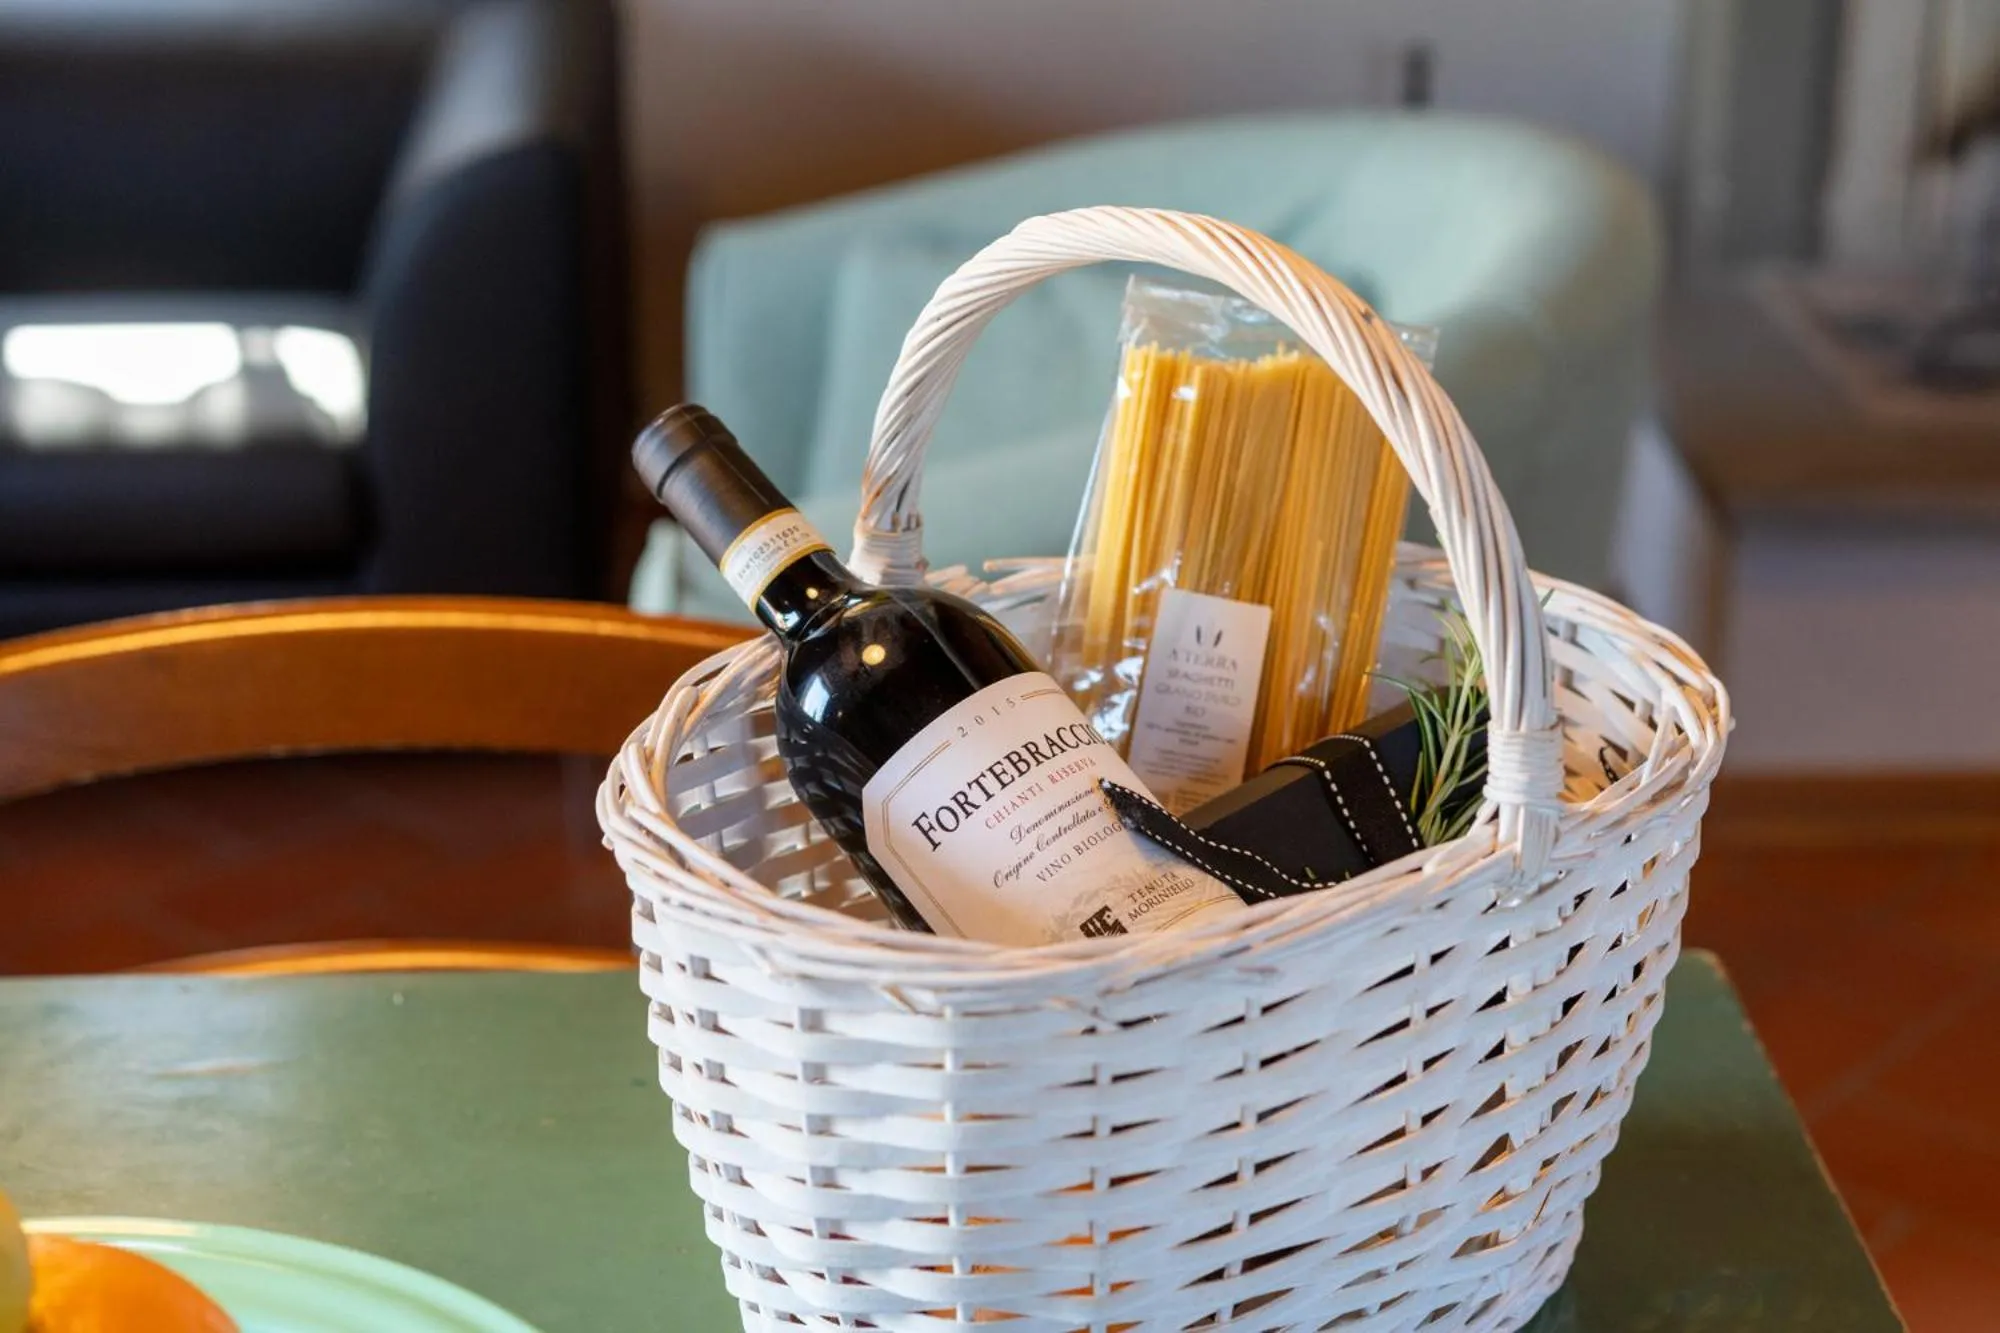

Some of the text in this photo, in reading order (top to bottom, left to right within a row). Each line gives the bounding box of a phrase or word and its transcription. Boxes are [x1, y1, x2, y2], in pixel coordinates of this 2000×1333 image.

[957, 697, 1016, 738] 2015
[984, 782, 1045, 830] CHIANTI
[1047, 756, 1097, 785] RISERVA
[993, 849, 1035, 889] Origine
[1035, 807, 1097, 853] Controllata
[1036, 820, 1123, 883] VINO BIOLOG
[1127, 870, 1180, 903] TENUTA
[1127, 877, 1195, 922] MORINIELLO
